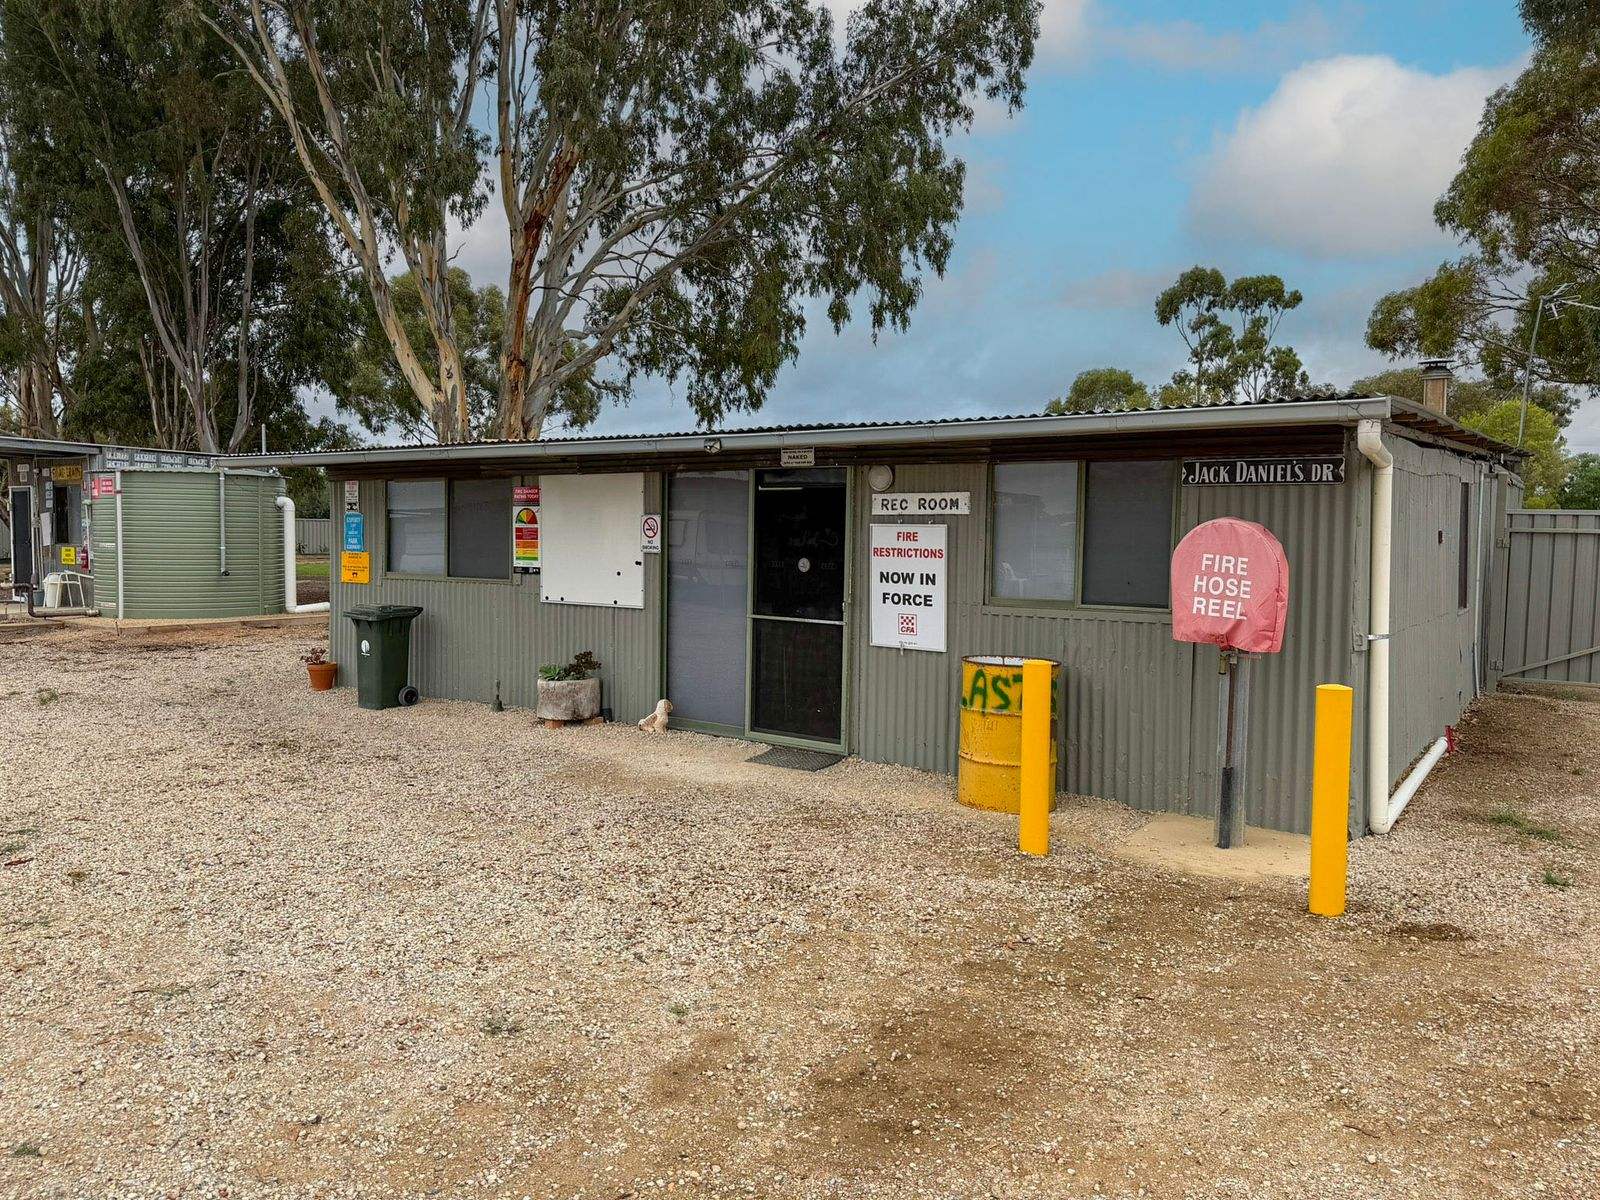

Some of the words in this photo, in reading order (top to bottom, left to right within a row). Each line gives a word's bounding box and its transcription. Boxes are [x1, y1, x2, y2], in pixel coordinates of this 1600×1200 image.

[1188, 462, 1230, 483] JACK
[1311, 464, 1334, 482] DR
[881, 499, 908, 511] REC
[918, 498, 960, 510] ROOM
[896, 531, 919, 542] FIRE
[873, 547, 944, 559] RESTRICTIONS
[1201, 553, 1249, 576] FIRE
[879, 571, 915, 586] NOW
[919, 573, 936, 586] IN
[1193, 574, 1252, 599] HOSE
[882, 592, 933, 607] FORCE
[1192, 596, 1247, 620] REEL
[900, 626, 915, 634] CFA
